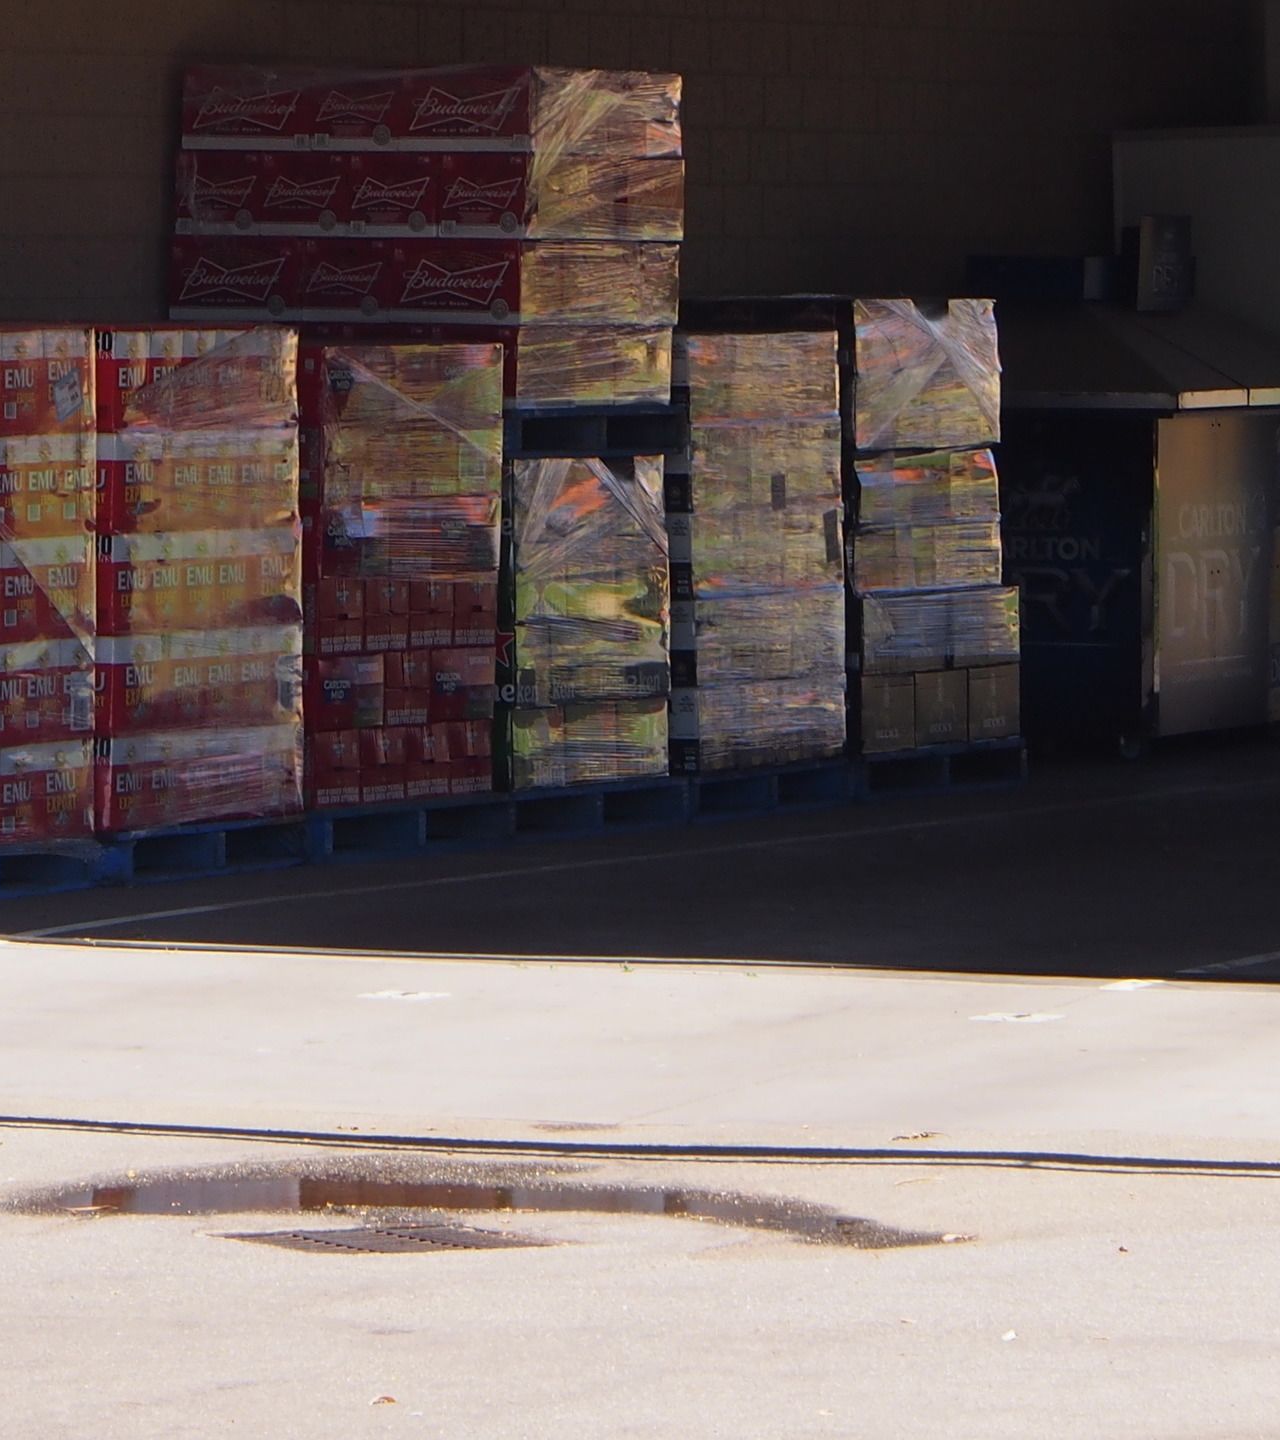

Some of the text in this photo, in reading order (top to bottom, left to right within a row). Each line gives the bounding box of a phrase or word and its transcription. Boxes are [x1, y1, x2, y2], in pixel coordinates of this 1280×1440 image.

[402, 270, 503, 288] Budweiser
[5, 367, 34, 389] EMU
[29, 471, 57, 491] EMU
[125, 463, 154, 483] EMU
[1179, 503, 1248, 538] CARLTON
[1004, 535, 1099, 561] RLTON
[5, 575, 34, 597] EMU
[187, 565, 213, 586] EMU
[1169, 545, 1260, 640] DRY
[125, 665, 154, 686] EMU
[27, 677, 56, 698] EMU
[3, 781, 31, 803] EMU
[47, 771, 76, 793] EMU
